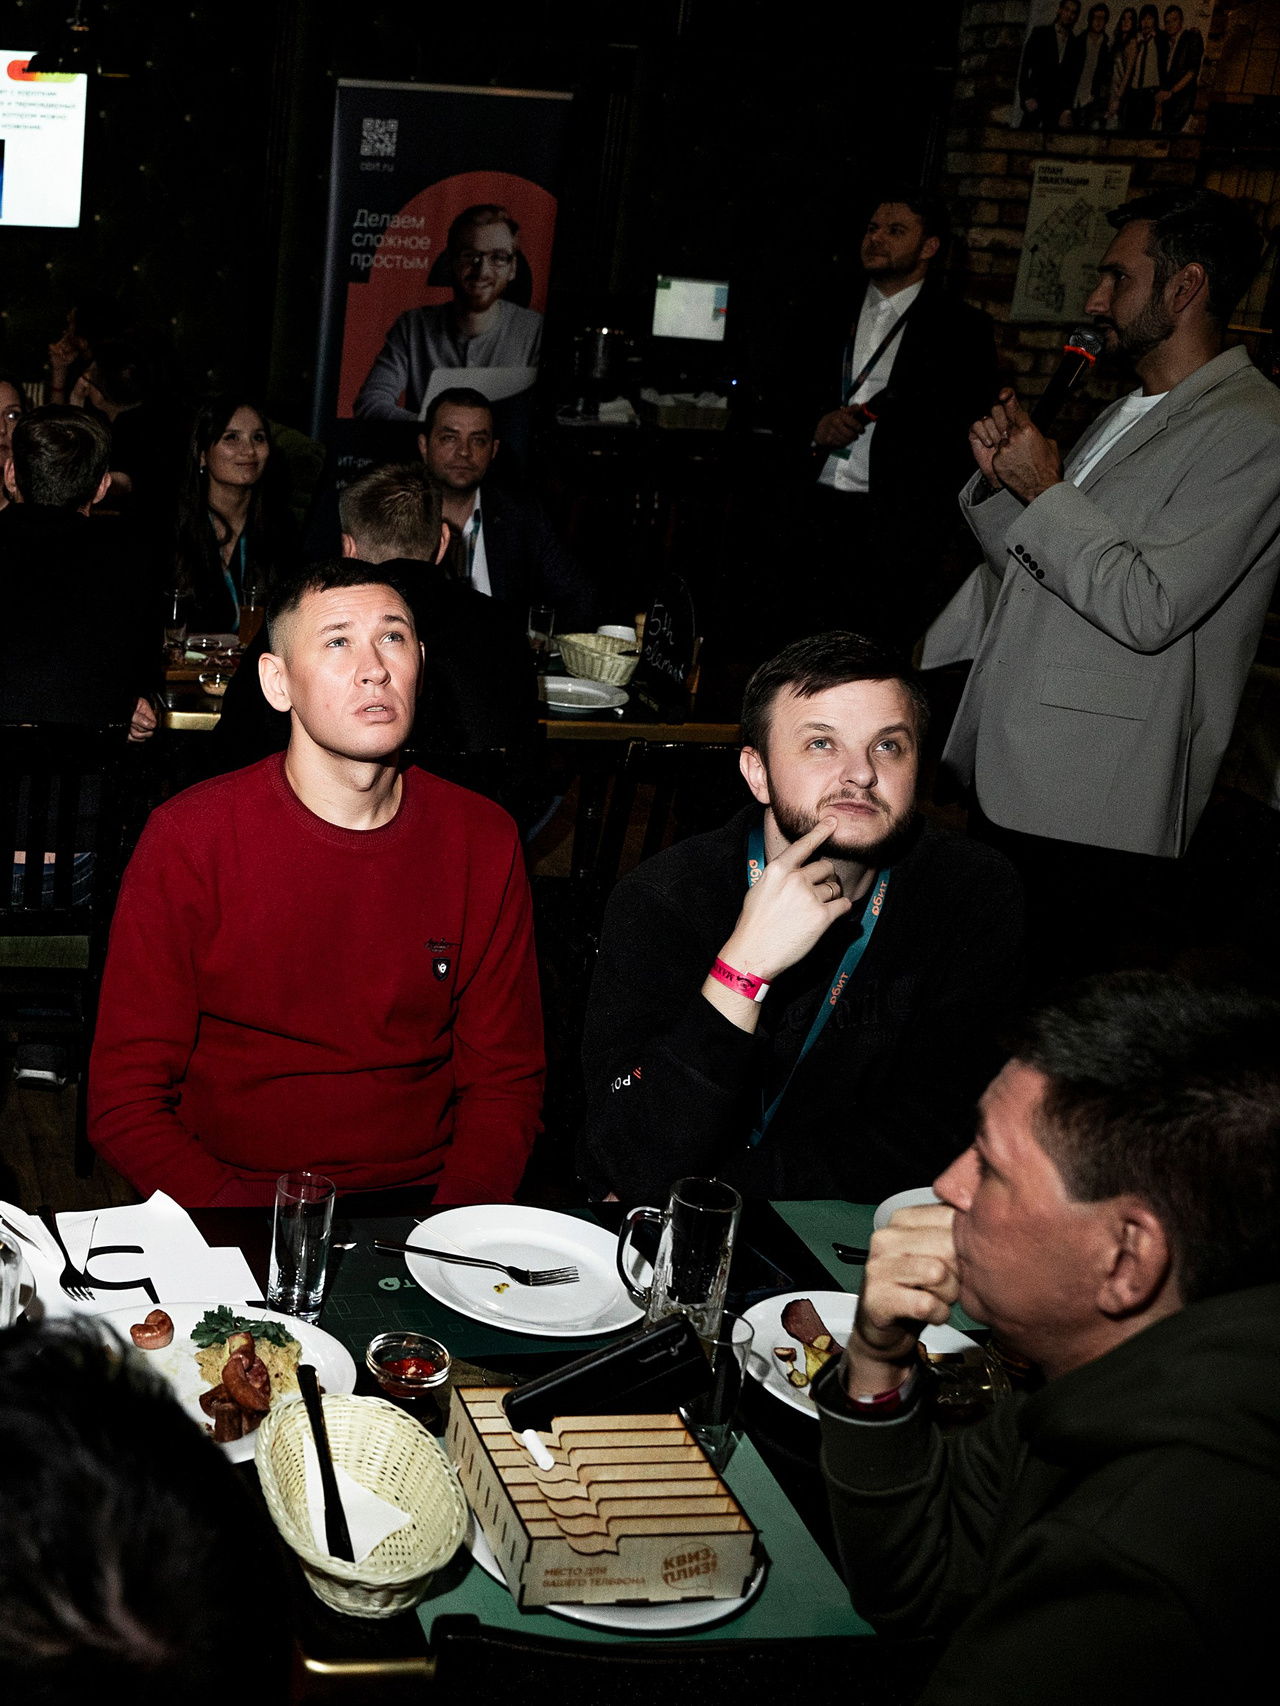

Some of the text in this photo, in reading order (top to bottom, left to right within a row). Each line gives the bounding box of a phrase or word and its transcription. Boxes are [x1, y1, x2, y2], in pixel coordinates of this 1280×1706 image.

[353, 208, 426, 229] Делаем
[351, 232, 431, 250] сложное
[349, 252, 429, 271] простым
[544, 1567, 607, 1576] МЕСТО ДЛЯ
[542, 1577, 646, 1587] ВАШЕГО ТЕЛЕФОНА
